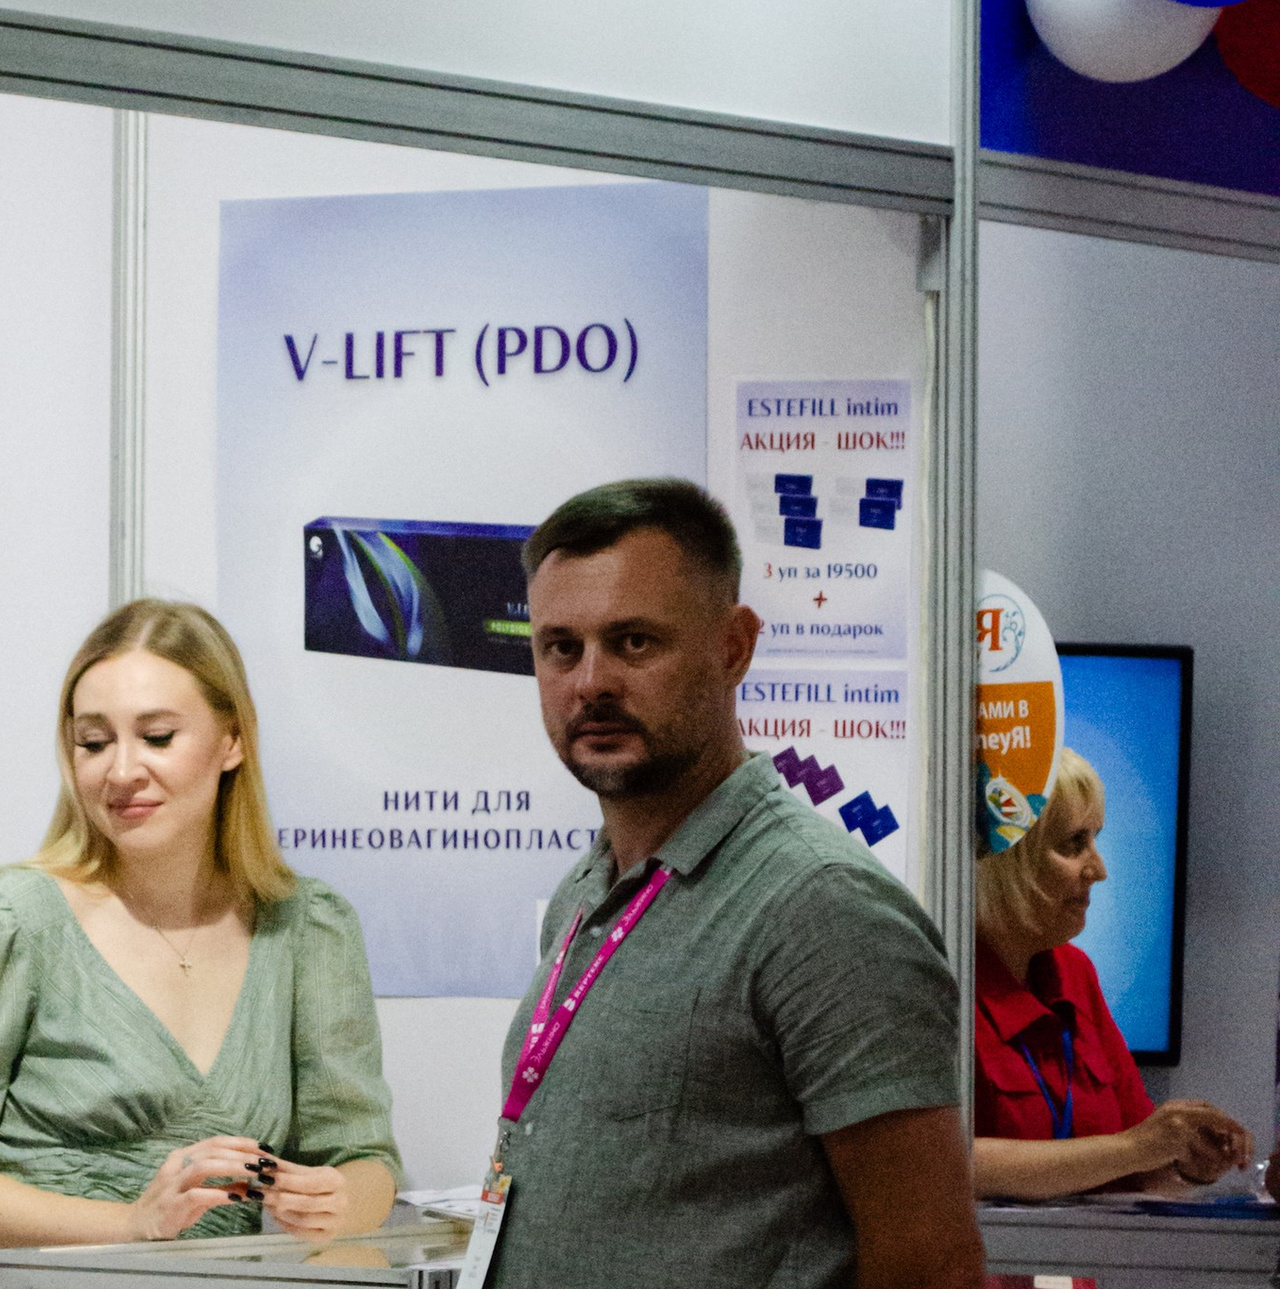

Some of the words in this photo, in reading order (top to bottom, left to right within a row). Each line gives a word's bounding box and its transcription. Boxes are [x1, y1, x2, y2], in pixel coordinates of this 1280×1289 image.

[283, 328, 456, 381] V-LIFT
[475, 317, 639, 387] (PDO)
[747, 398, 840, 417] ESTEFILL
[847, 397, 898, 416] intim
[740, 431, 815, 453] АКЦИЯ
[837, 431, 906, 450] ШОК!!!
[764, 563, 772, 578] 3
[778, 566, 797, 581] уп
[804, 566, 820, 578] за
[827, 564, 877, 578] 19500
[771, 622, 790, 637] уп
[796, 623, 804, 634] в
[810, 622, 883, 639] подарок
[741, 682, 836, 702] ESTEFILL
[844, 683, 899, 703] intim
[1018, 699, 1030, 719] В
[834, 719, 906, 739] ШОК!!!
[383, 790, 459, 811] НИТИ
[472, 790, 531, 815] ДЛЯ
